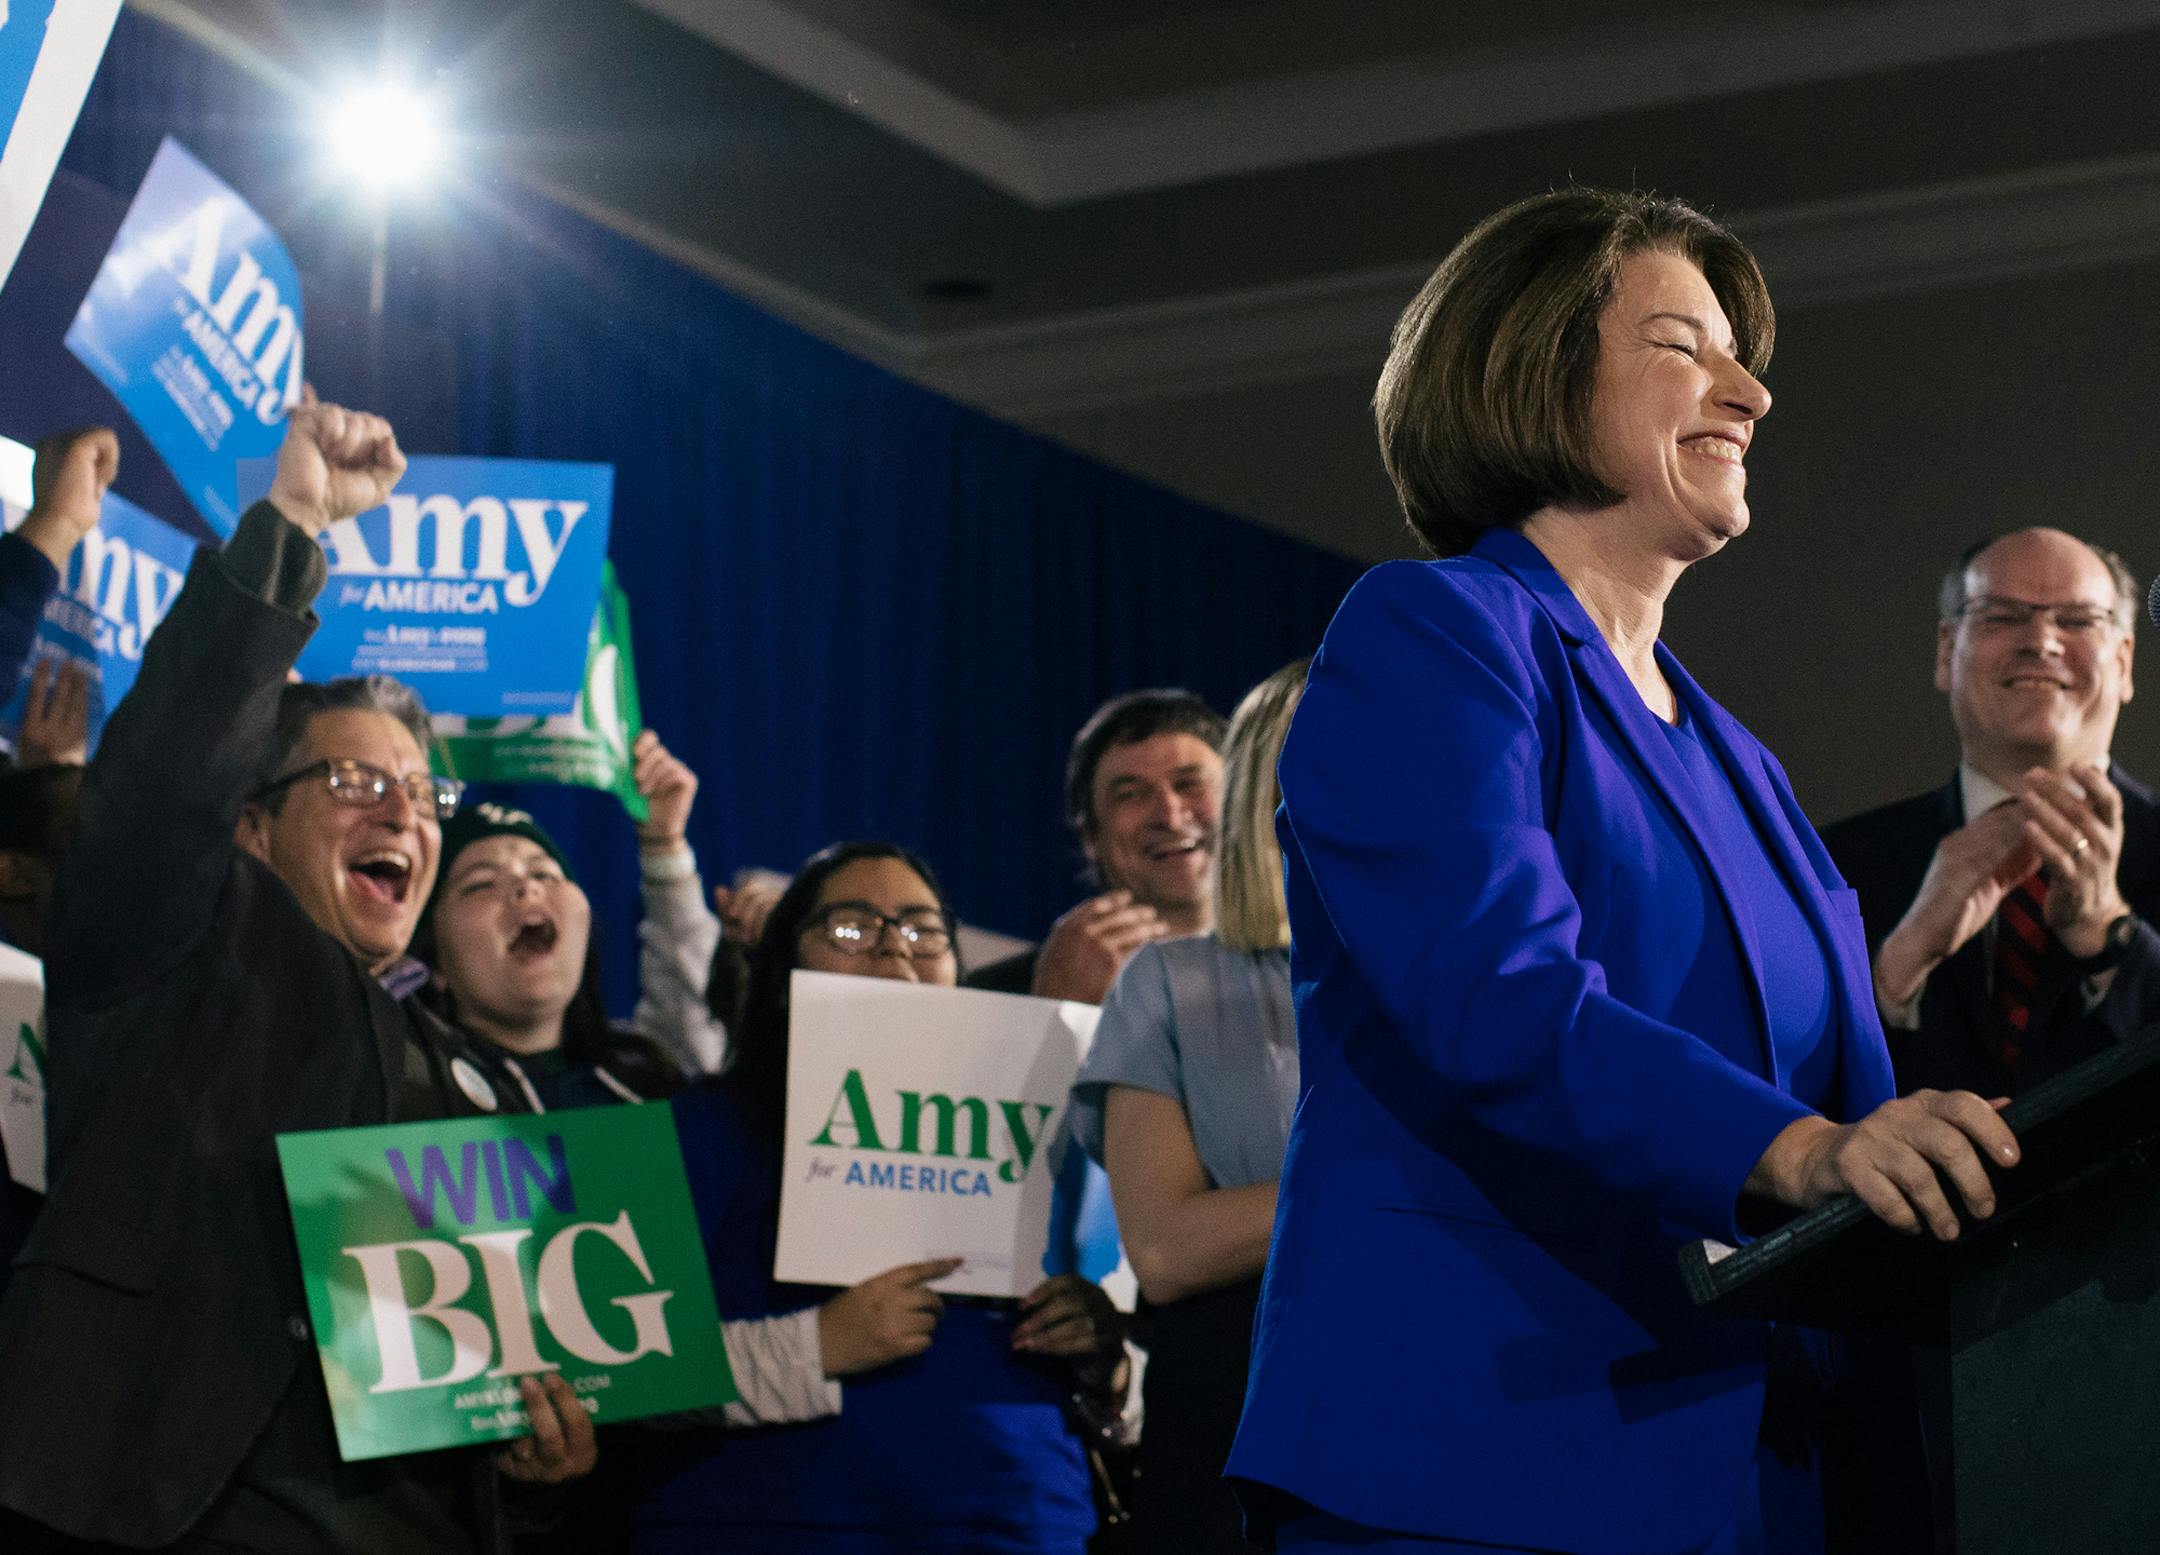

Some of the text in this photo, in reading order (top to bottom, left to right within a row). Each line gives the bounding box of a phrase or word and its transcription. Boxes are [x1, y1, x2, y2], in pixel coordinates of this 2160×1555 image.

[363, 578, 500, 614] AMERICA
[807, 1068, 1055, 1184] Amy
[384, 1133, 578, 1230] WIN
[804, 1157, 992, 1198] for AMERICA
[340, 1208, 674, 1394] BIG
